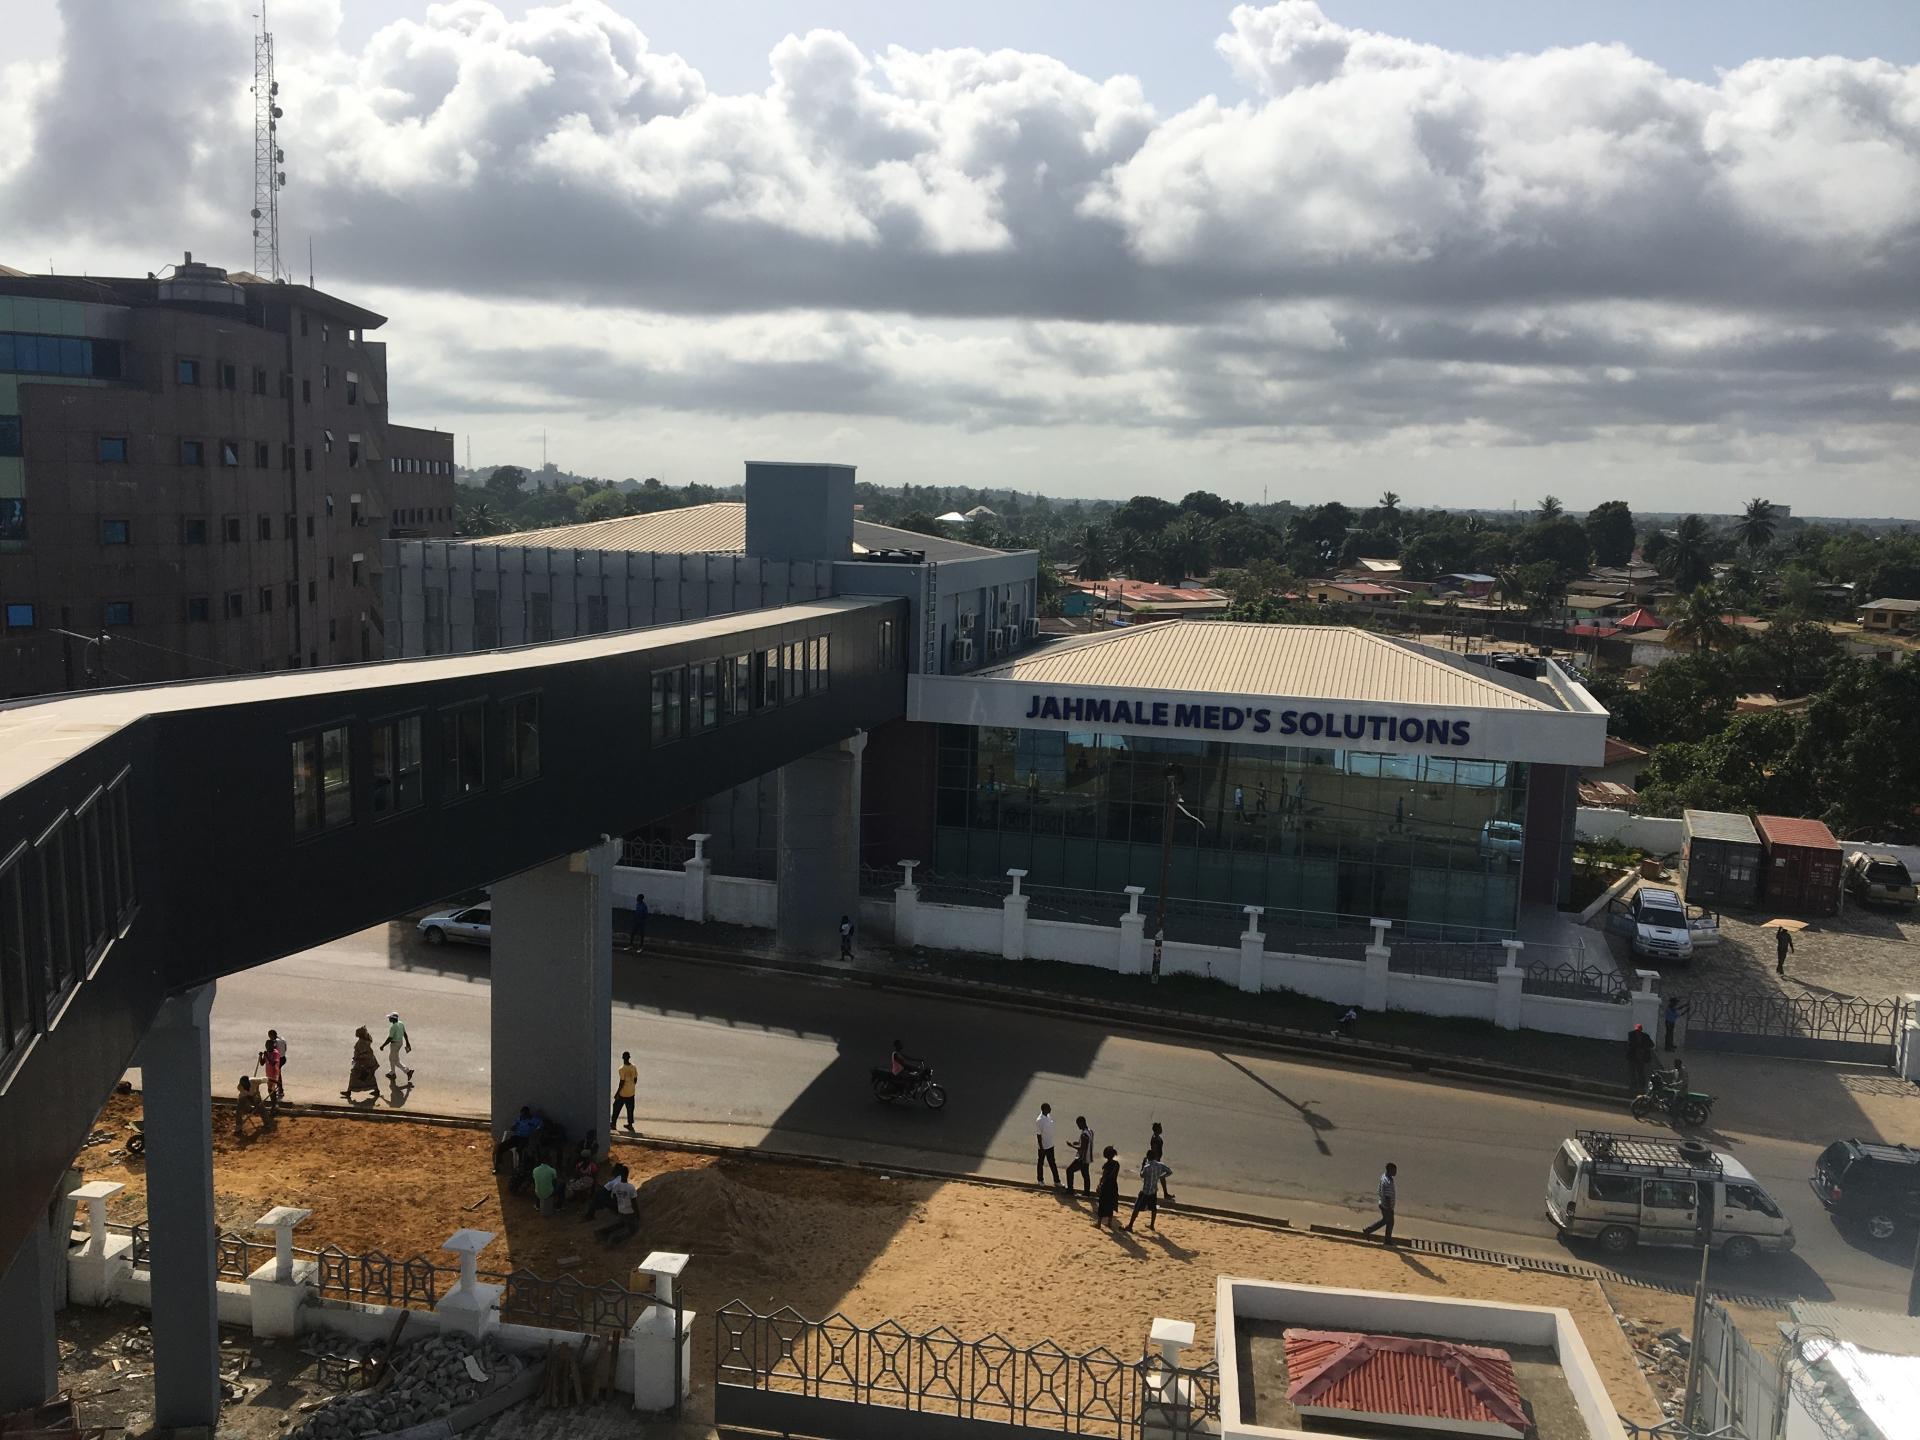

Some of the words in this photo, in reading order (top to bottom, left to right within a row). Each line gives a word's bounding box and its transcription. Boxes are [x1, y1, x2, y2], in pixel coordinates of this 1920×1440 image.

[1026, 695, 1168, 726] JAHMALE
[1174, 703, 1271, 733] MED'S
[1280, 710, 1471, 746] SOLUTIONS
